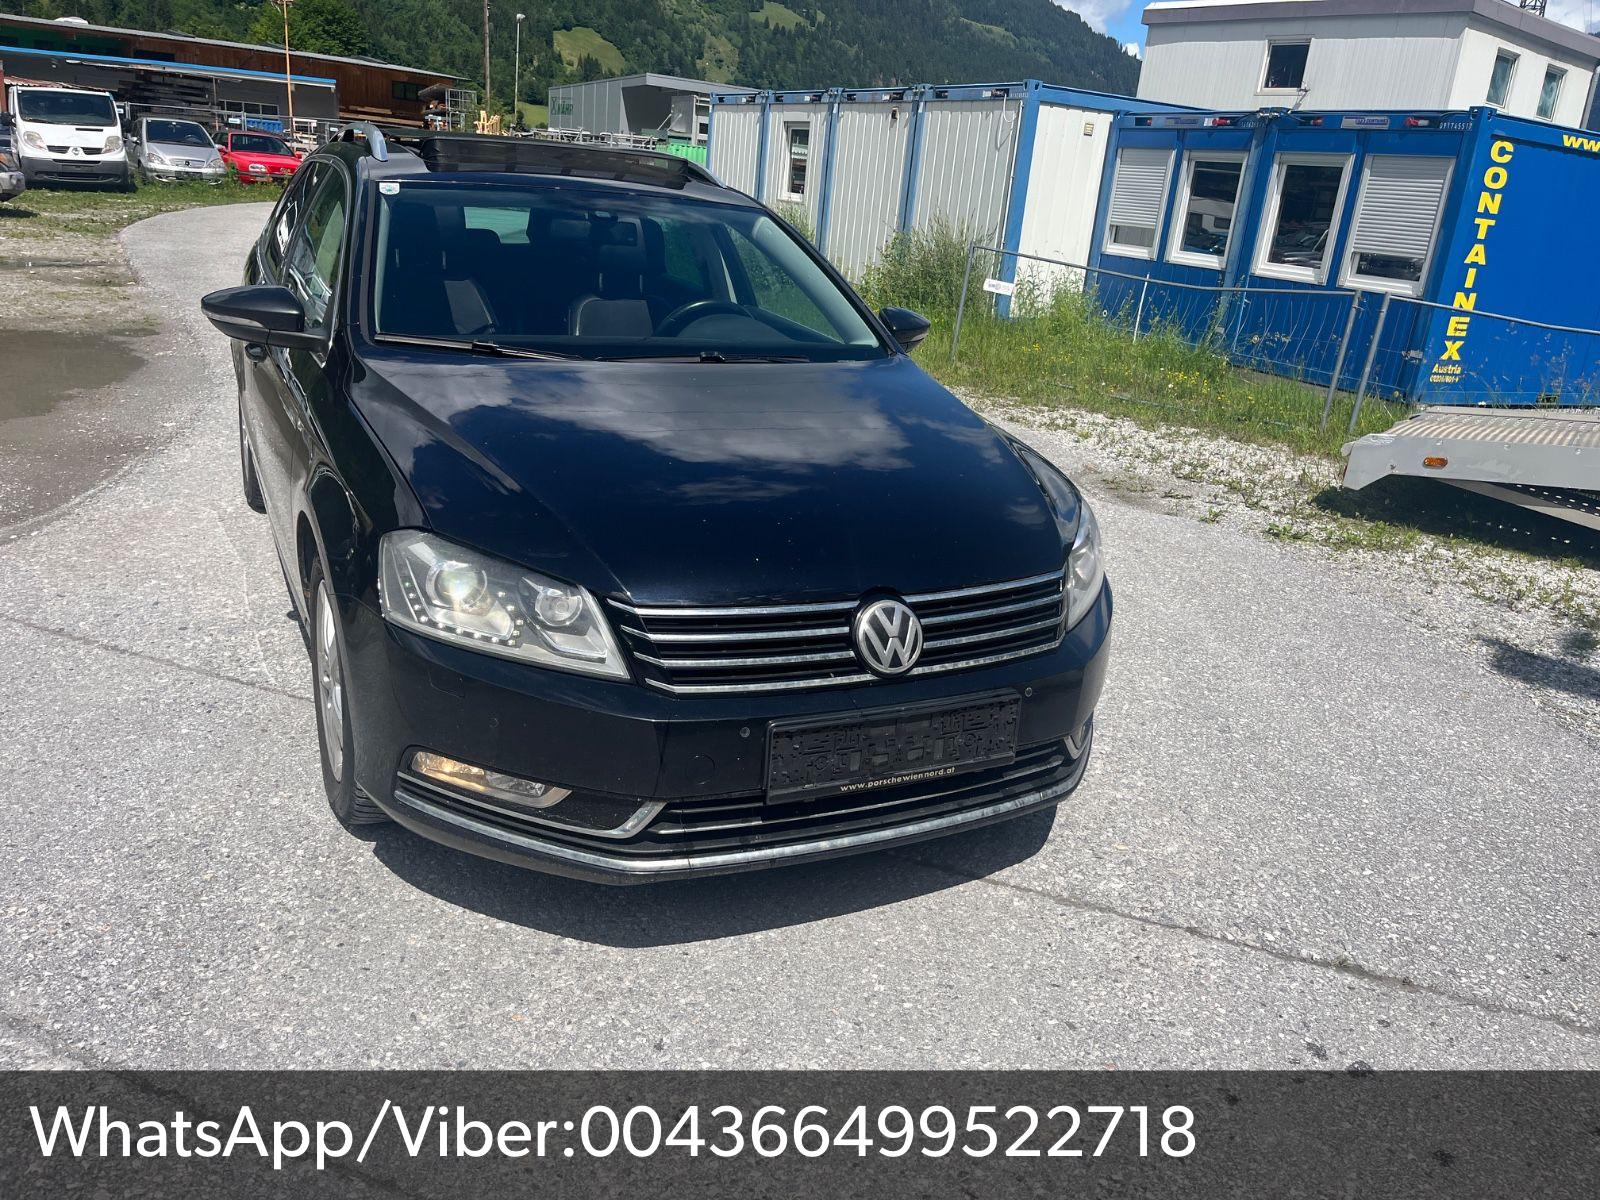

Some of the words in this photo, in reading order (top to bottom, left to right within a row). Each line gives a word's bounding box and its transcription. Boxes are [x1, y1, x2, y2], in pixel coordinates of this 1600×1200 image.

[1440, 140, 1514, 360] CONTAINEX
[1432, 363, 1462, 375] Austria
[856, 599, 923, 673] VW
